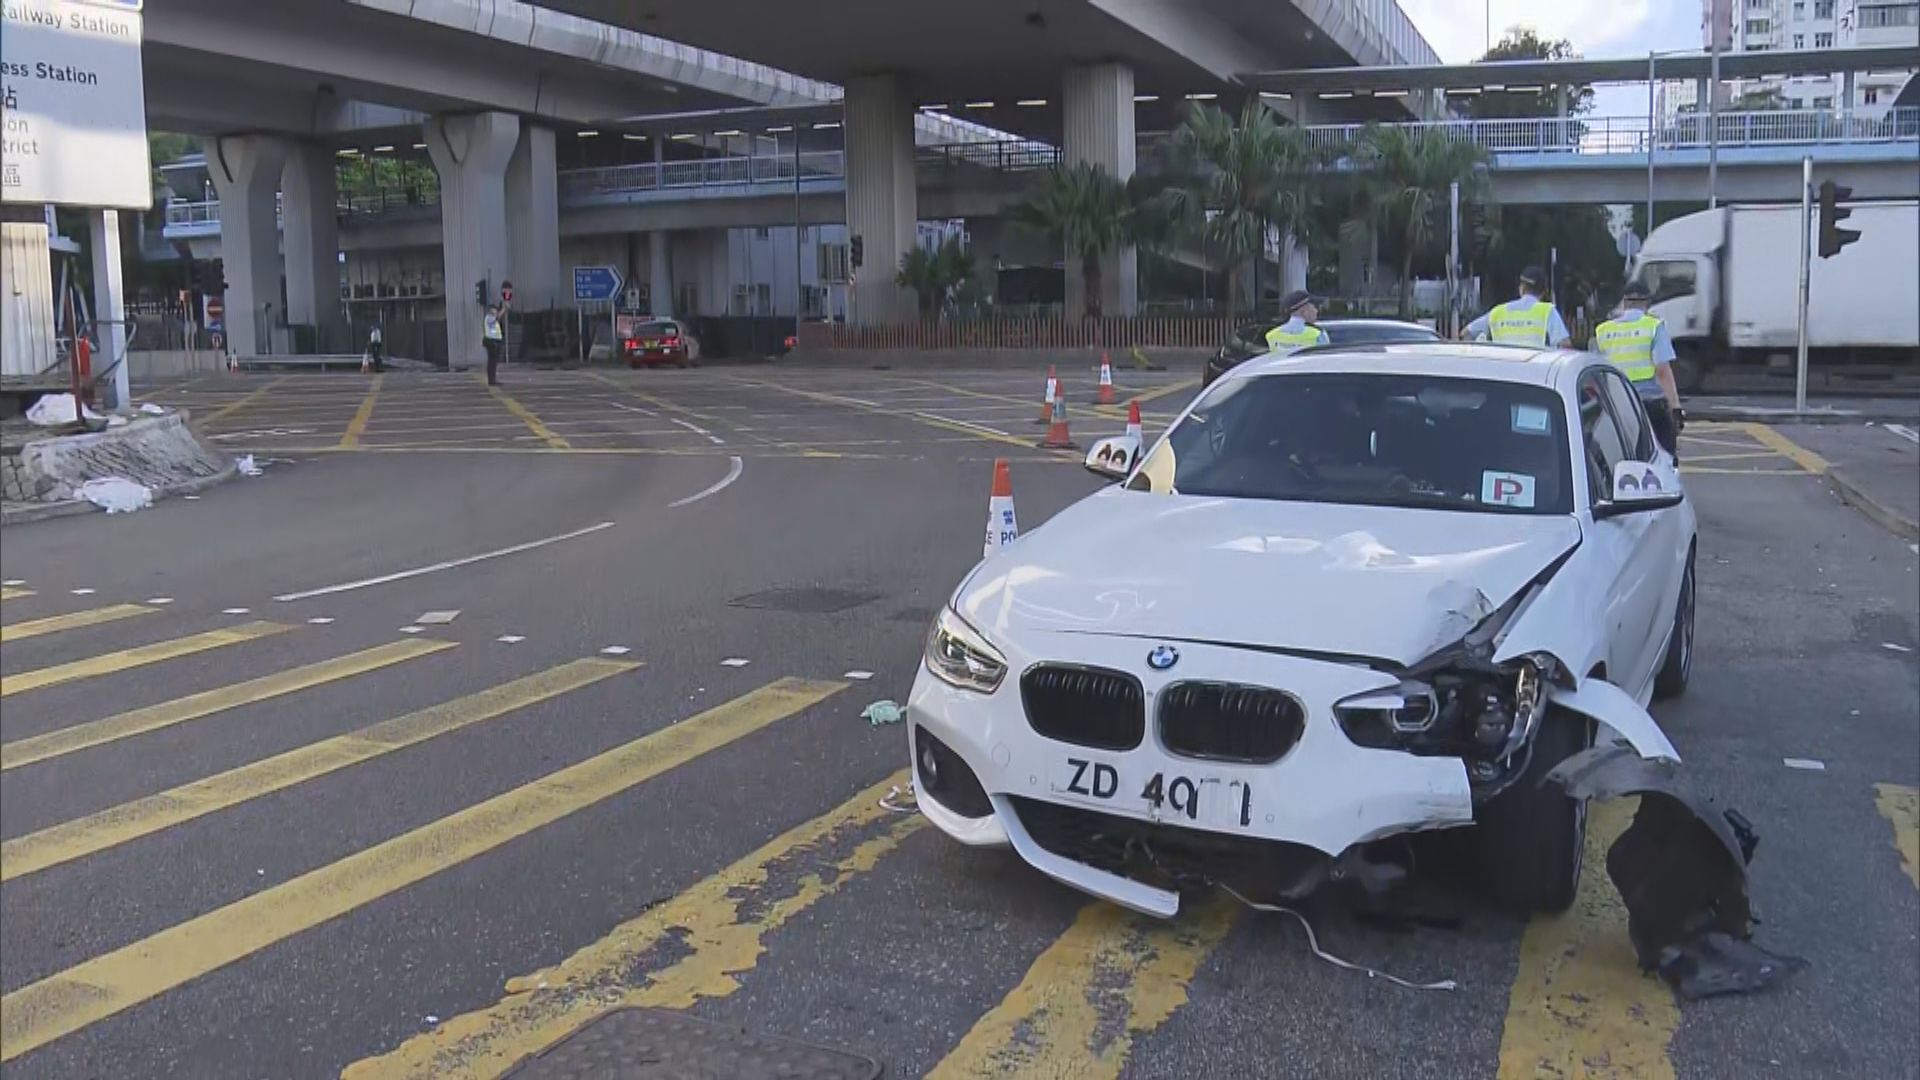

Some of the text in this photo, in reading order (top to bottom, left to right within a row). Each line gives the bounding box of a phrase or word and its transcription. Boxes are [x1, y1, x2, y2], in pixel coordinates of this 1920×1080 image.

[70, 13, 129, 36] Station
[36, 61, 97, 86] Station
[1494, 478, 1523, 501] P
[1067, 757, 1118, 799] ZD
